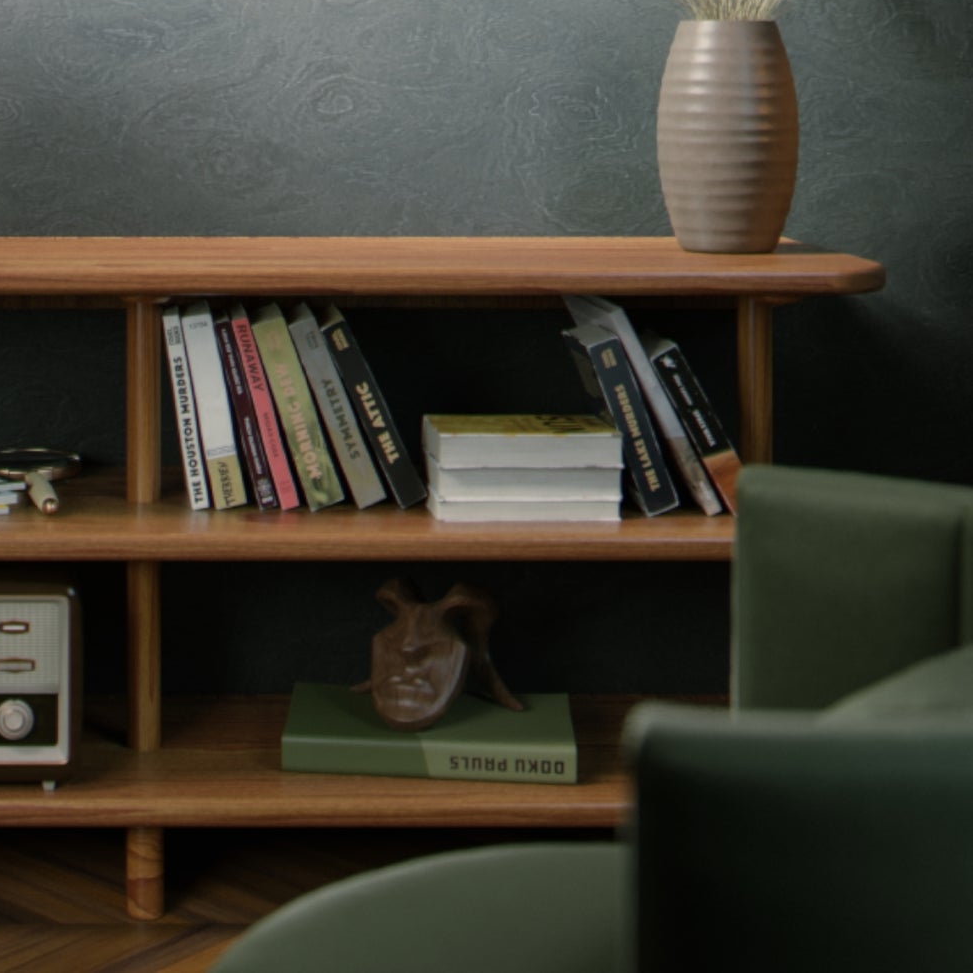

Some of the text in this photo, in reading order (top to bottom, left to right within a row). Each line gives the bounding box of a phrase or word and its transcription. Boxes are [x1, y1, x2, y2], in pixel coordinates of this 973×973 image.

[237, 324, 265, 392] RUNAWAY
[173, 357, 204, 503] THE HOUSTON MURDERS
[275, 364, 323, 479] MORNING DEW
[320, 378, 360, 460] SYMMETRY
[355, 381, 401, 465] THE ATTIC
[613, 383, 641, 439] MURDERS
[645, 468, 661, 493] THE
